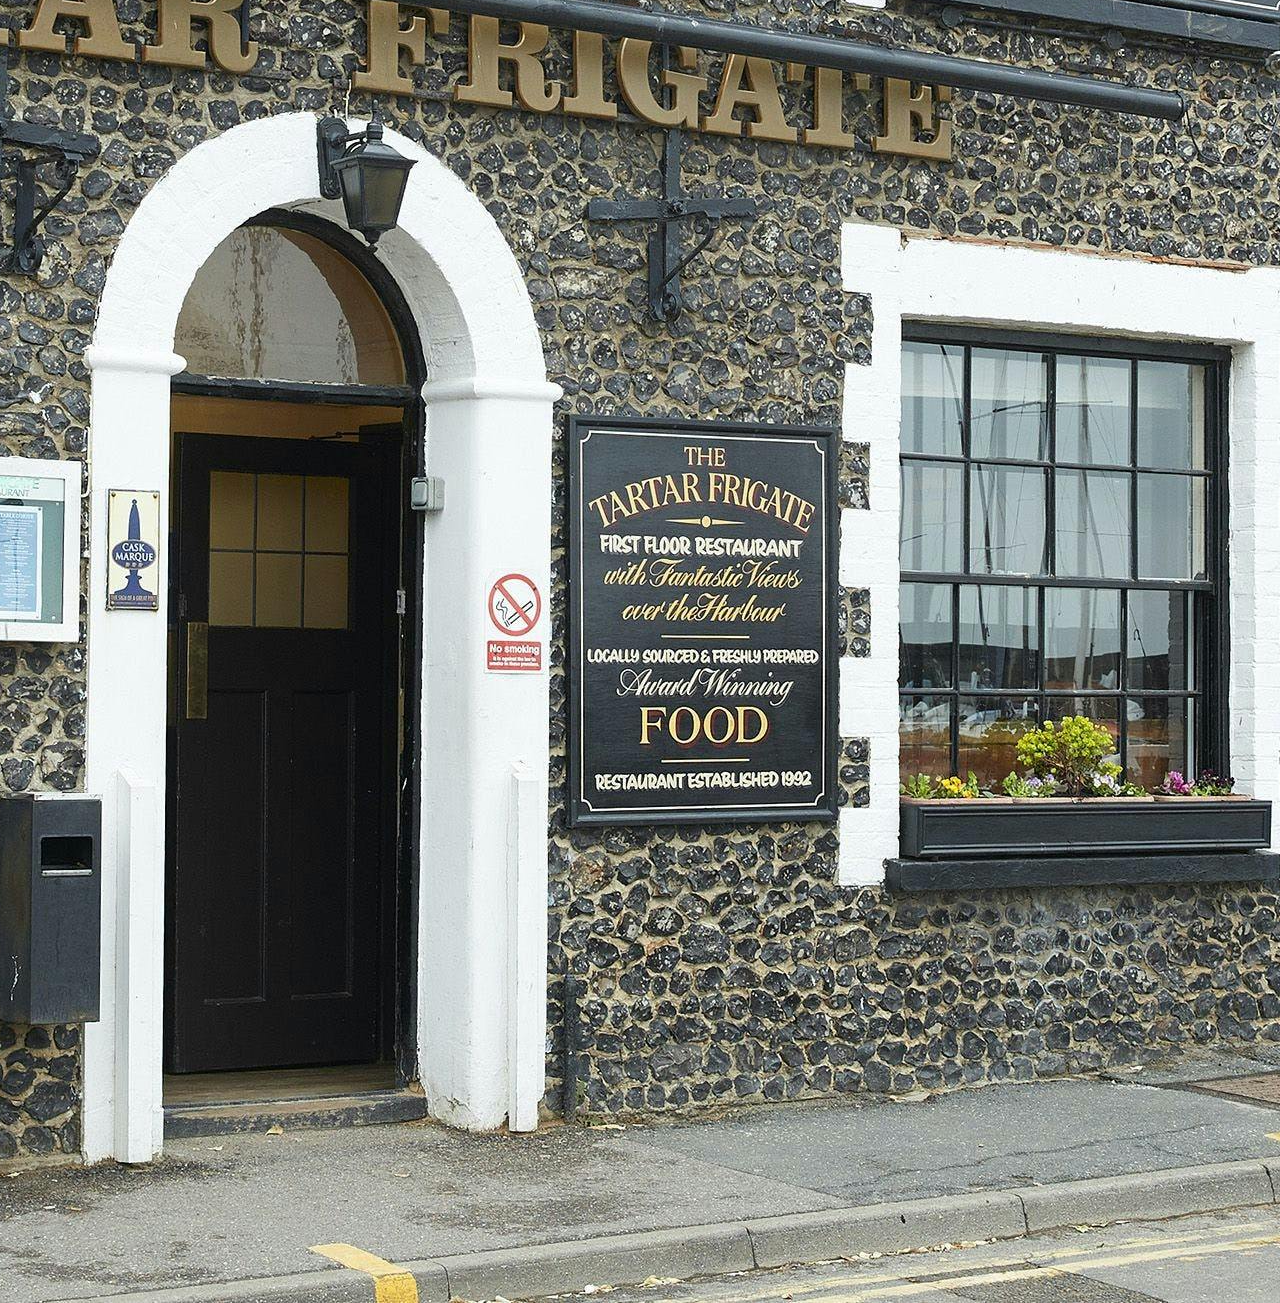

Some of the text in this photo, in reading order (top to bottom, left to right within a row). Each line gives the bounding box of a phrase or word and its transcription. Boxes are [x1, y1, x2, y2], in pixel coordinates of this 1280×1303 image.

[353, 0, 952, 161] FRIGATE
[684, 446, 726, 466] THE
[588, 471, 817, 533] TARTAR FRIGATE
[115, 552, 154, 562] MARQUE
[122, 542, 146, 552] CASK
[599, 534, 804, 558] FIRST FLOOR RESTAURANT
[604, 558, 803, 589] with Fantastic Views
[622, 592, 787, 623] over the Harbour
[489, 643, 540, 655] No smoking
[587, 648, 819, 665] LOCALLY SOURCED & FRESHLY PREPARED
[616, 667, 794, 707] Award Winning
[639, 705, 770, 746] FOOD
[595, 770, 812, 791] RESTAURANT ESTABLISHED 1992
